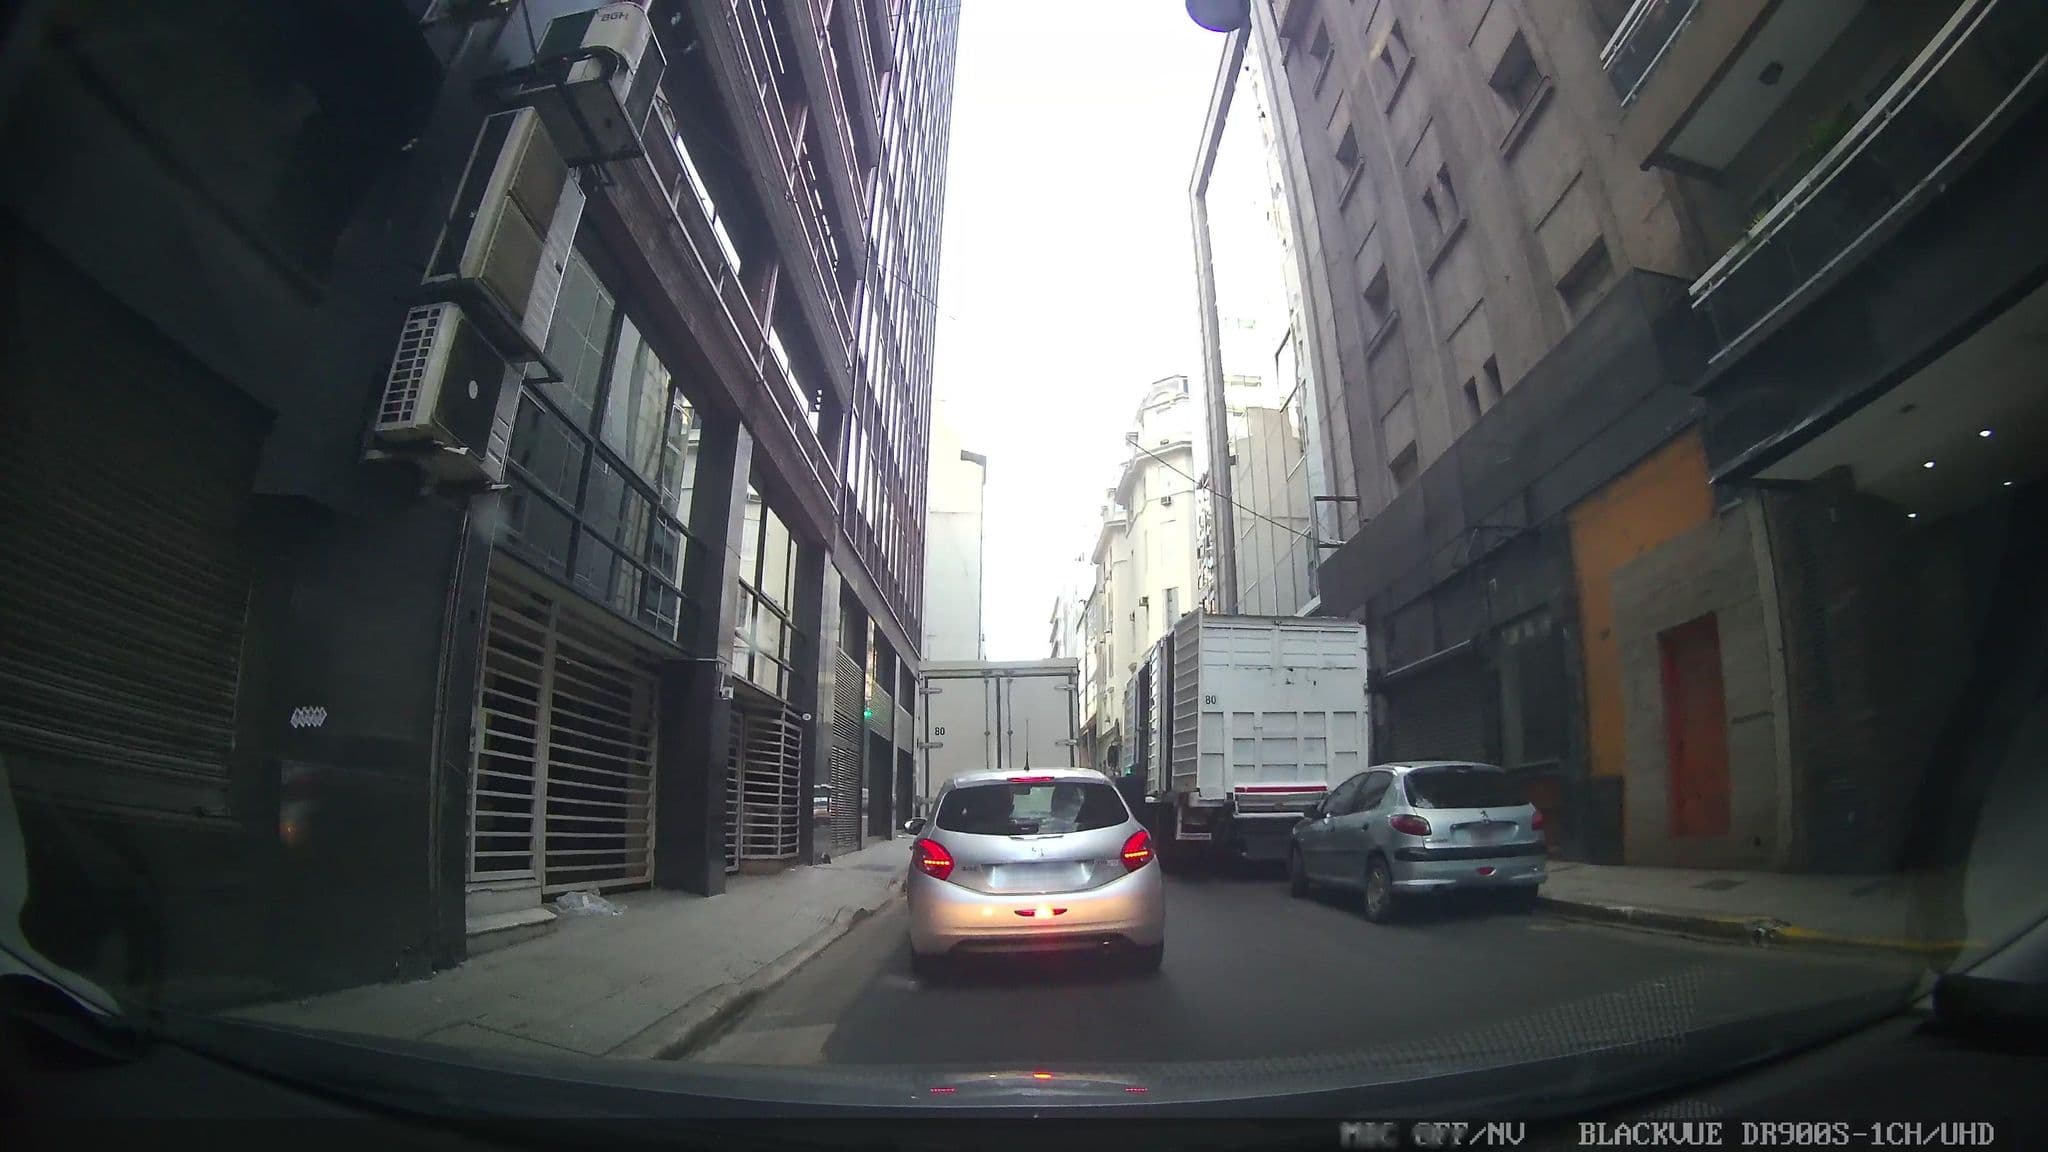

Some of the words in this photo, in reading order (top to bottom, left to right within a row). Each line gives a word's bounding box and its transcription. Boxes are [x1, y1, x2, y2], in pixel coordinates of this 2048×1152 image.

[601, 11, 629, 21] BGH
[1205, 695, 1217, 705] 80
[934, 727, 946, 736] 80
